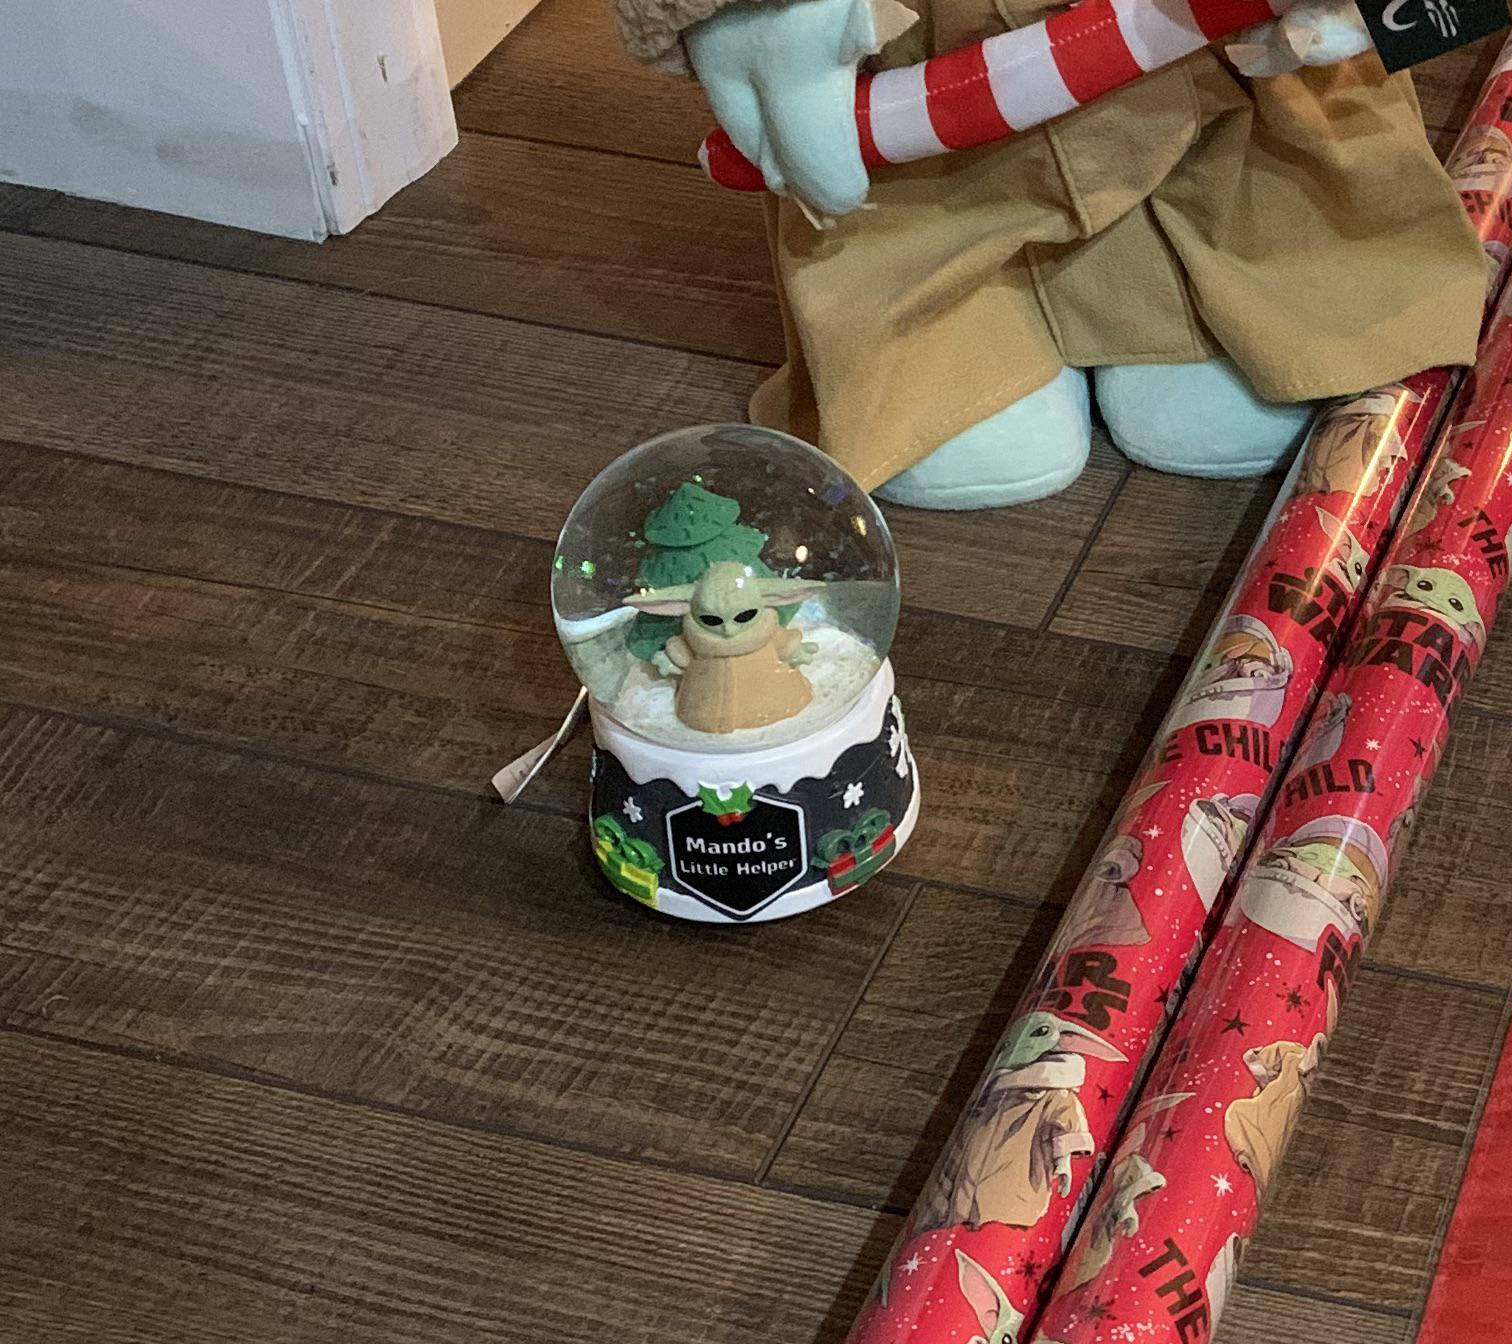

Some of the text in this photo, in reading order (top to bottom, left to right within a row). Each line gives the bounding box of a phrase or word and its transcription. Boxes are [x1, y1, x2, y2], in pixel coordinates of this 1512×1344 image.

[1457, 508, 1509, 580] THE
[1196, 722, 1284, 774] CHIL
[1284, 758, 1376, 804] HILD
[686, 832, 788, 854] Mando's
[680, 858, 797, 875] Little Helper
